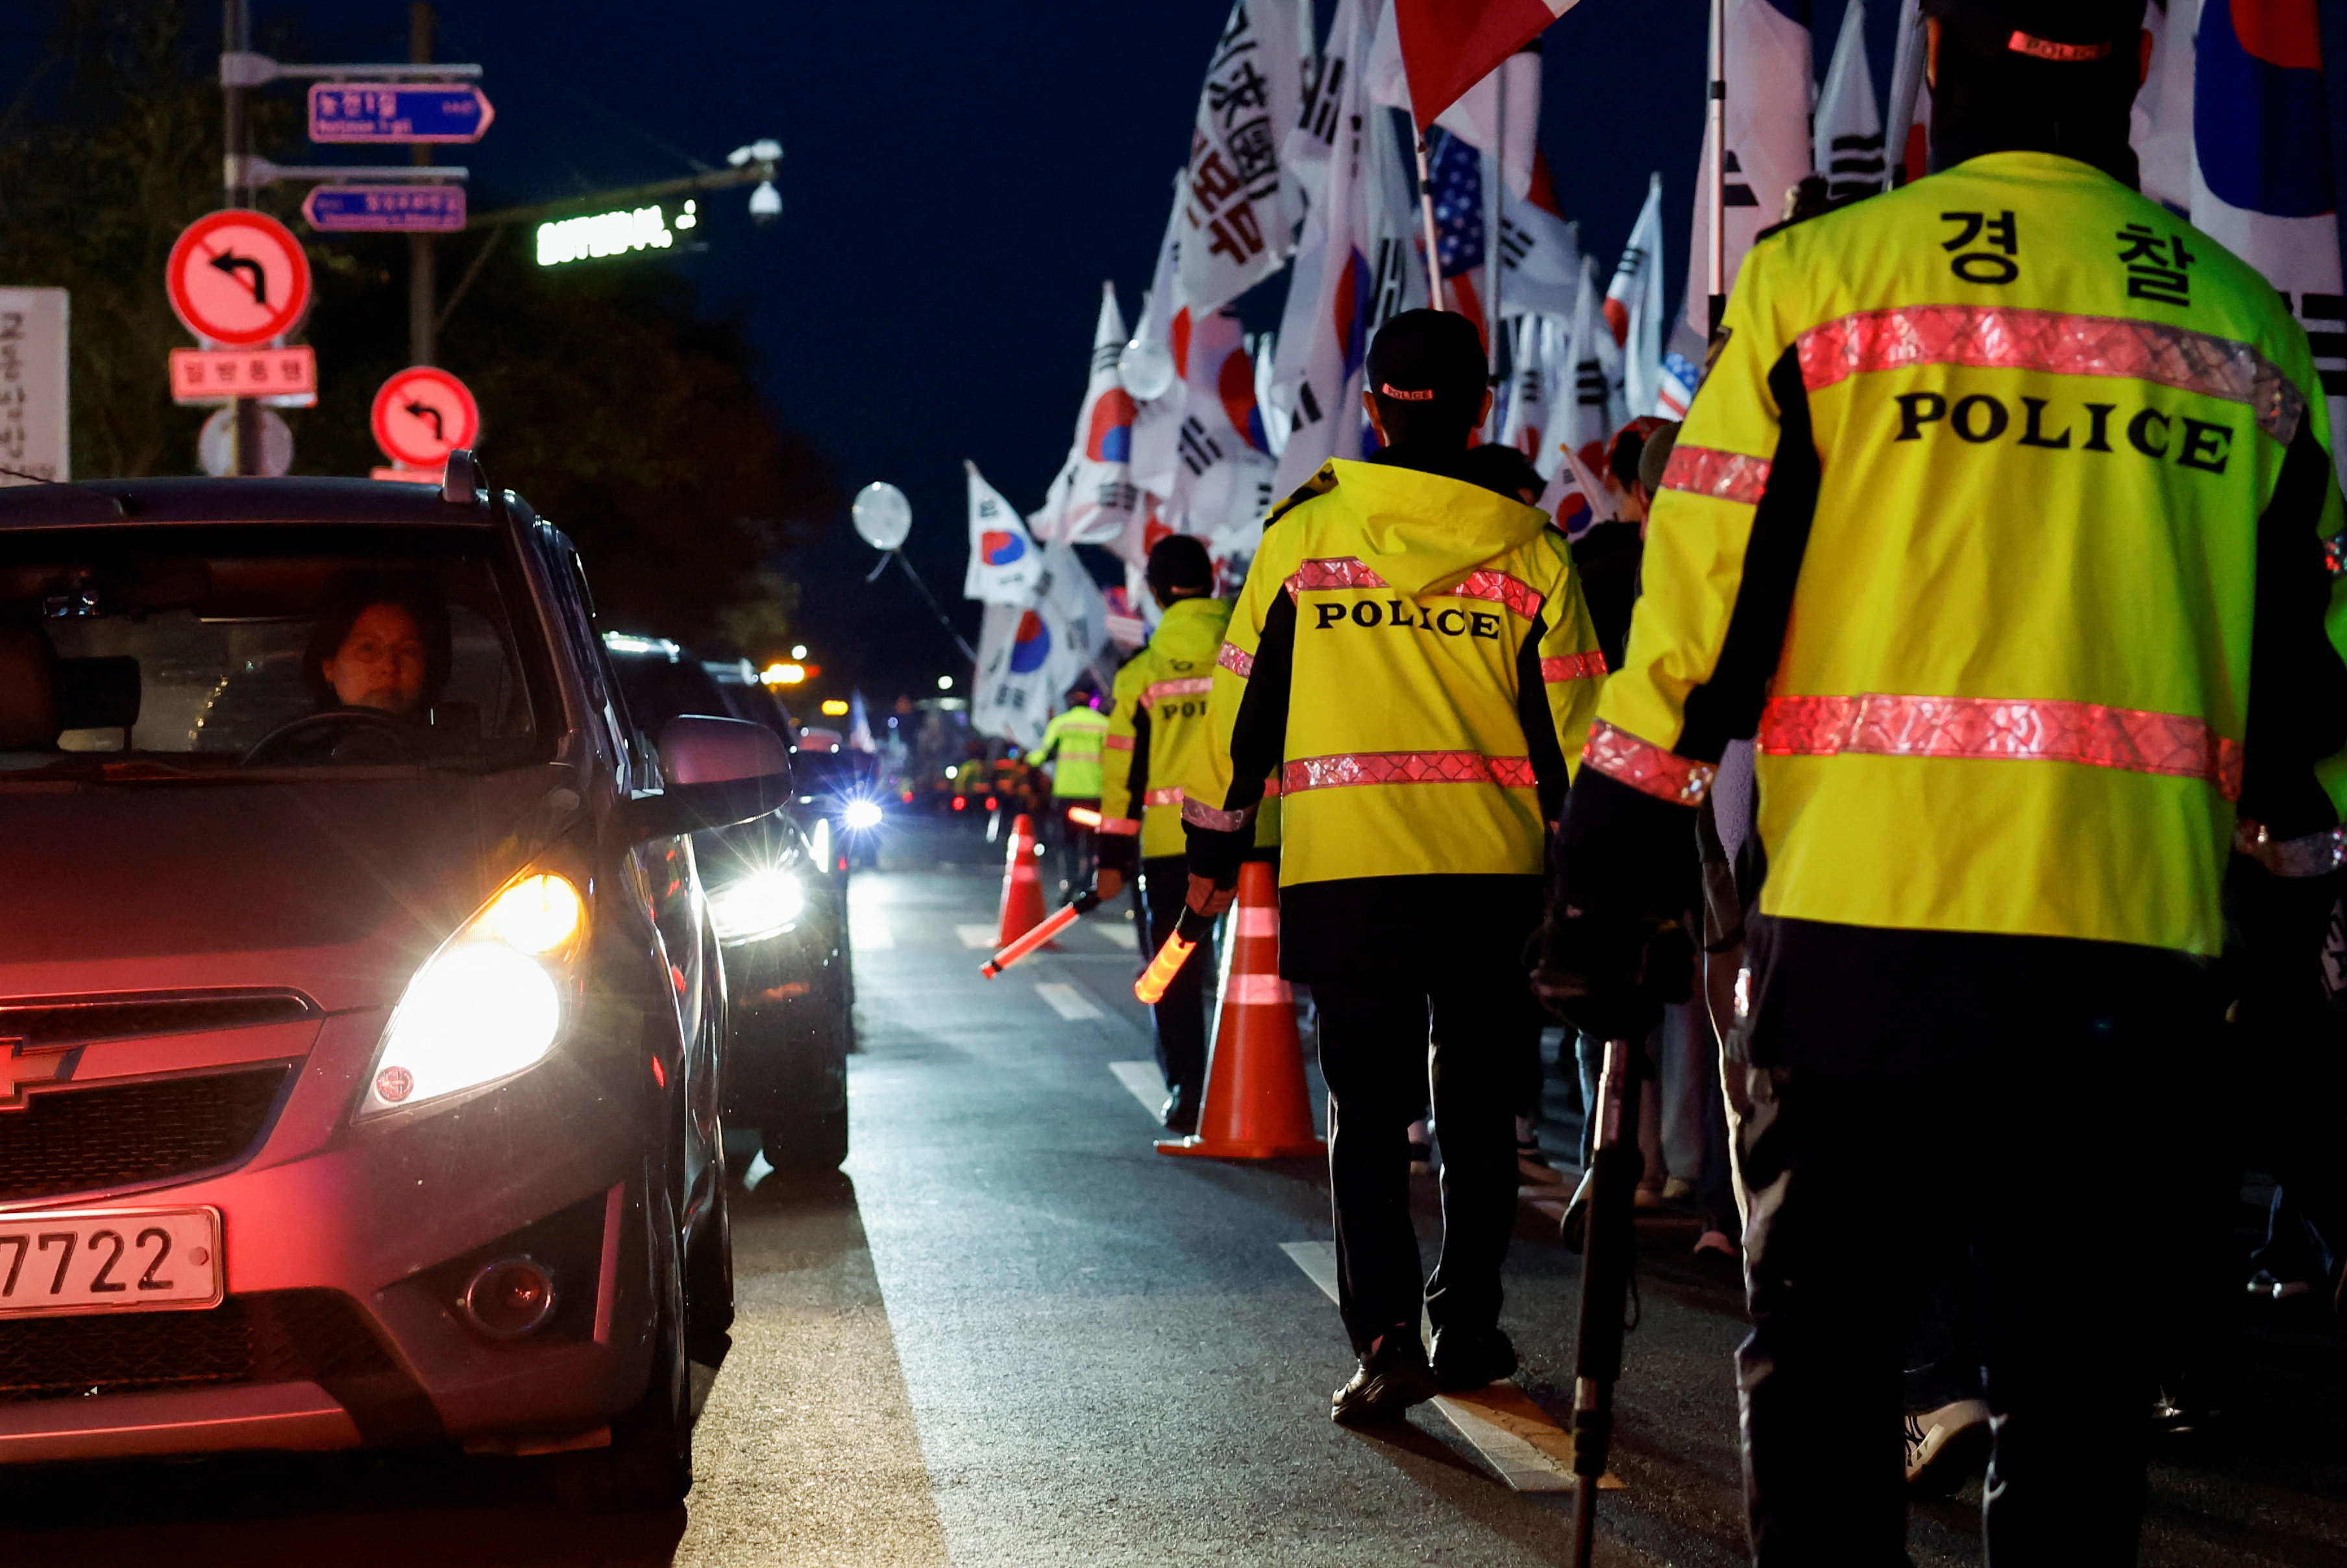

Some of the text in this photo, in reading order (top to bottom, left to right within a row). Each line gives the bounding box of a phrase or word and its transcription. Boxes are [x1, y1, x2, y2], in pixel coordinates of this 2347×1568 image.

[1895, 391, 2235, 474] POLICE
[1314, 600, 1502, 639] POLICE
[0, 1226, 174, 1297] 7722
